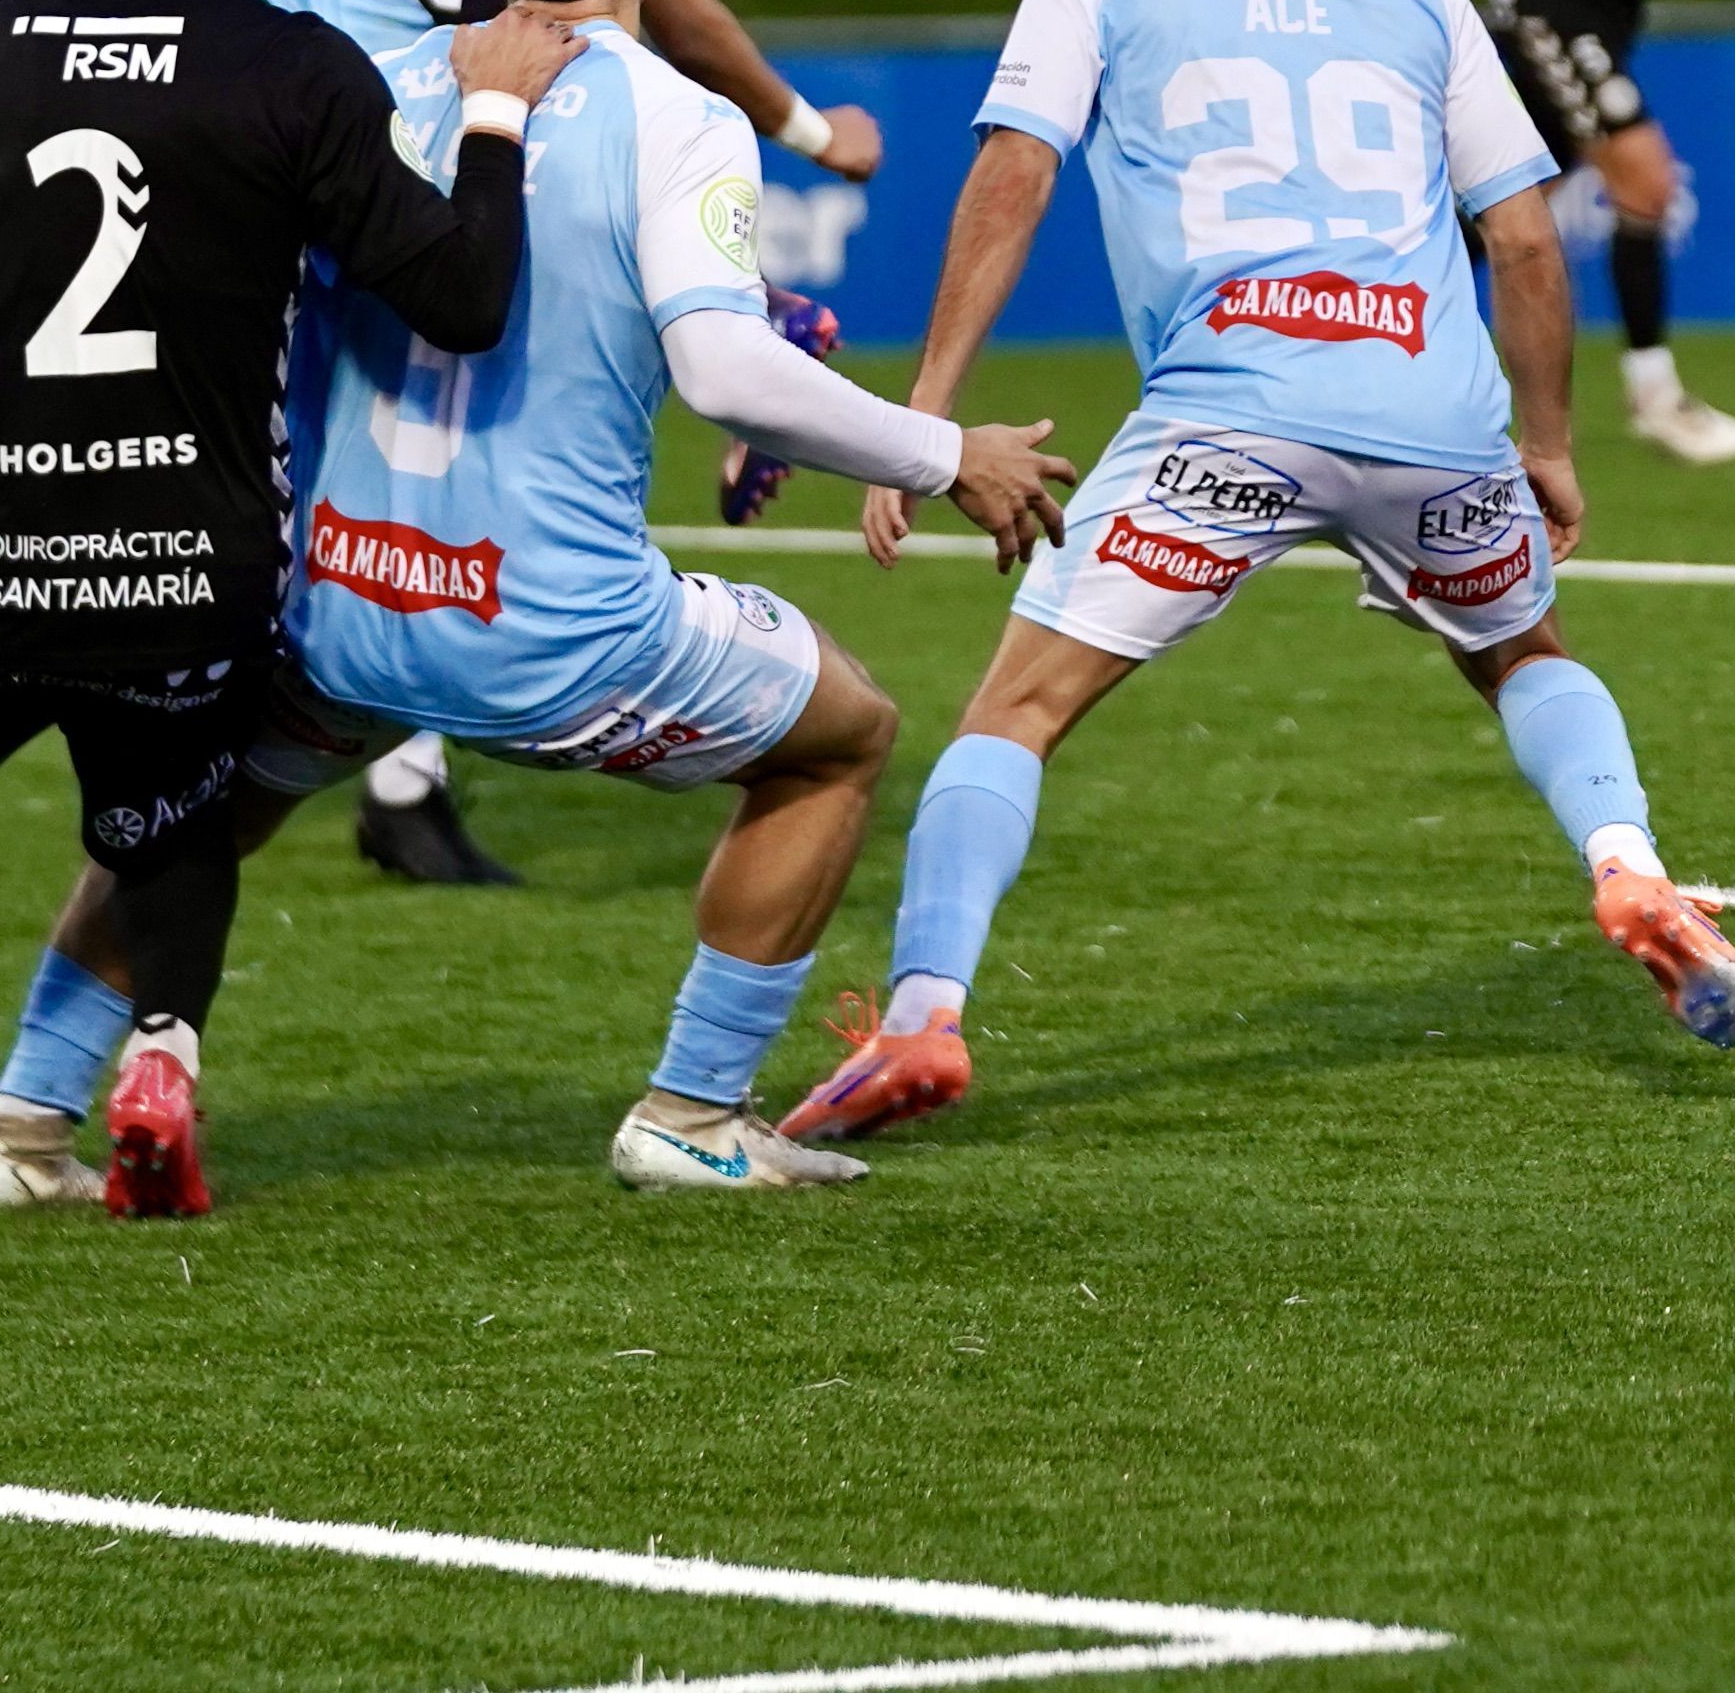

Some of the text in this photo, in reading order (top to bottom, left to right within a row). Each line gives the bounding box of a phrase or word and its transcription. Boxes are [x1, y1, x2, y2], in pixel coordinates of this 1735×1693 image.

[63, 43, 178, 83] RSM
[1163, 57, 1436, 263] 29
[25, 128, 157, 377] 2
[1223, 279, 1414, 336] CAMPOARAS
[0, 433, 198, 475] HOLGERS
[1155, 454, 1190, 493] EL
[1418, 509, 1454, 538] EL
[1109, 529, 1239, 587] CAMPOARAS
[117, 686, 224, 712] designer
